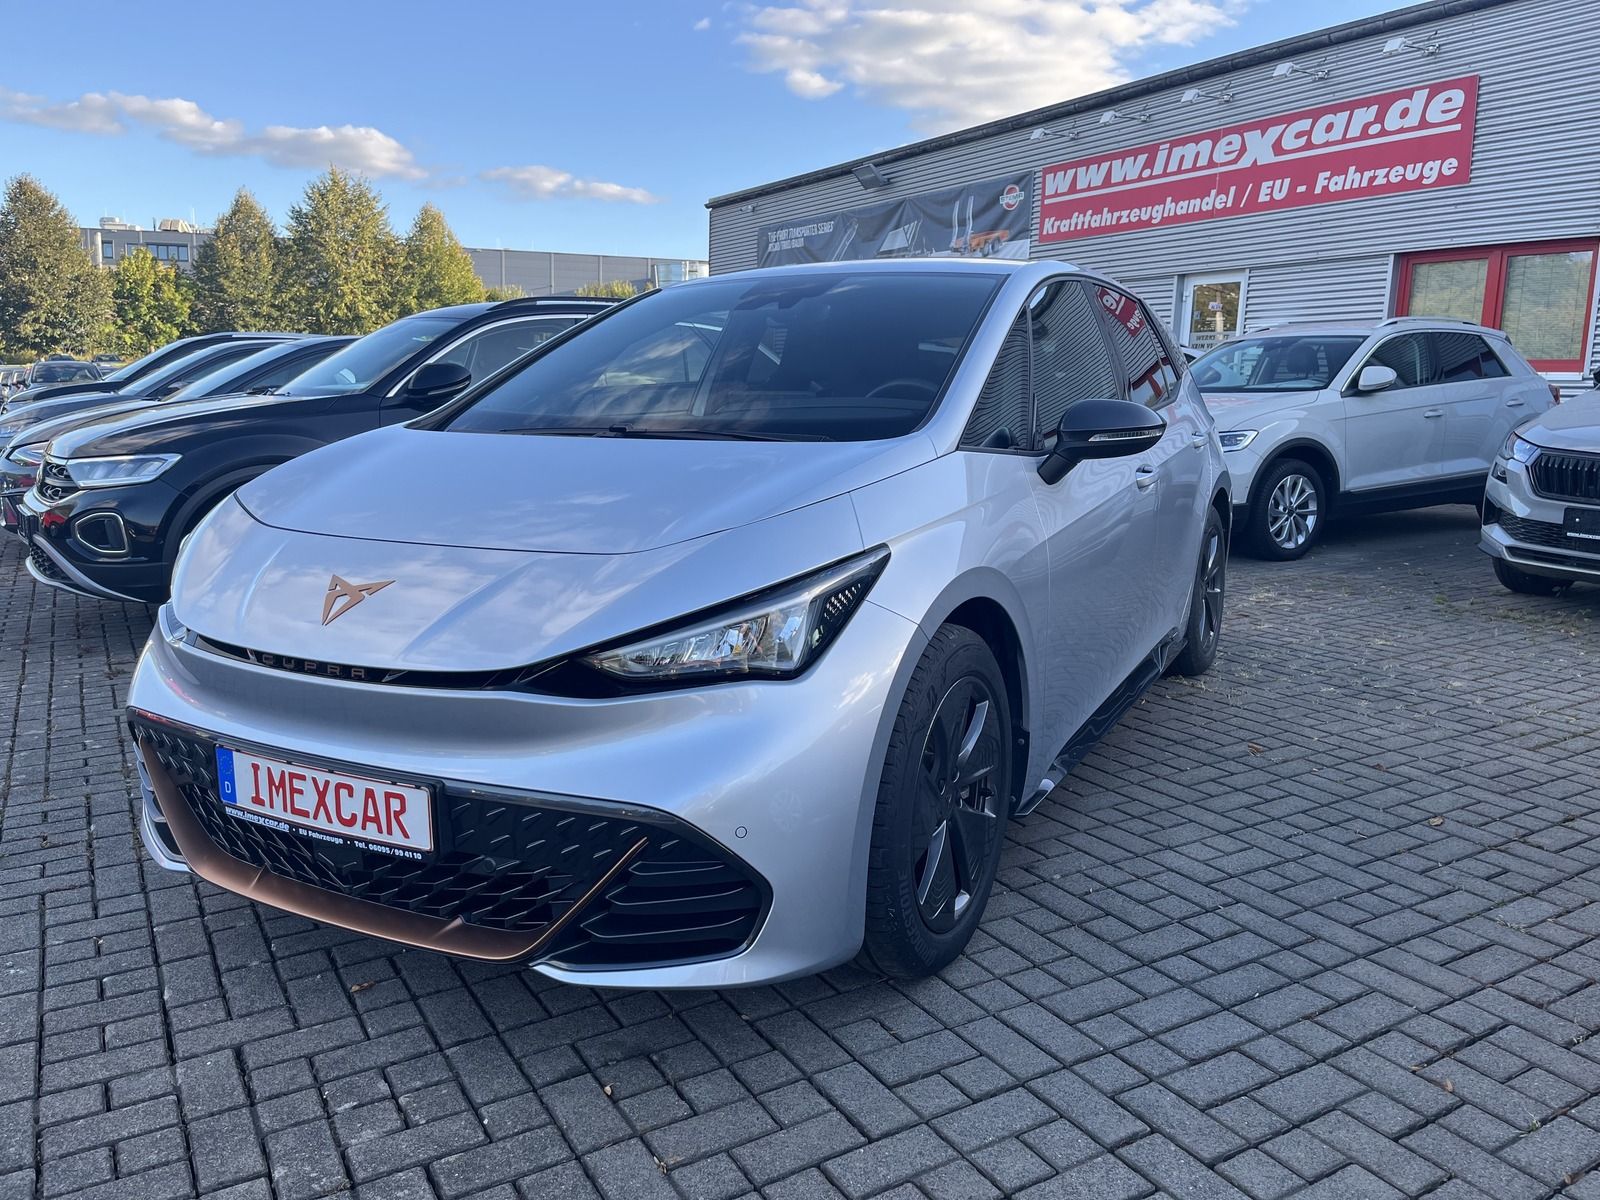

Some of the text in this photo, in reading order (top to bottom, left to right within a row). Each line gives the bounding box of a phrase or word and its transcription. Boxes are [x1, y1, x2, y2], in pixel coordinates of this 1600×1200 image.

[1044, 87, 1466, 197] www.imexcar.de
[1042, 185, 1236, 236] Kraftfahrzeughandel
[1240, 184, 1252, 208] /
[1258, 177, 1292, 203] EU
[1314, 155, 1459, 195] Fahrzeuge
[262, 653, 365, 679] CUPRA
[225, 781, 232, 794] D
[251, 762, 411, 840] IMEXCAR
[224, 806, 290, 832] www.imexcar.de
[298, 828, 308, 837] EU
[308, 830, 344, 845] Fahrzeuge
[354, 840, 368, 849] Tel.
